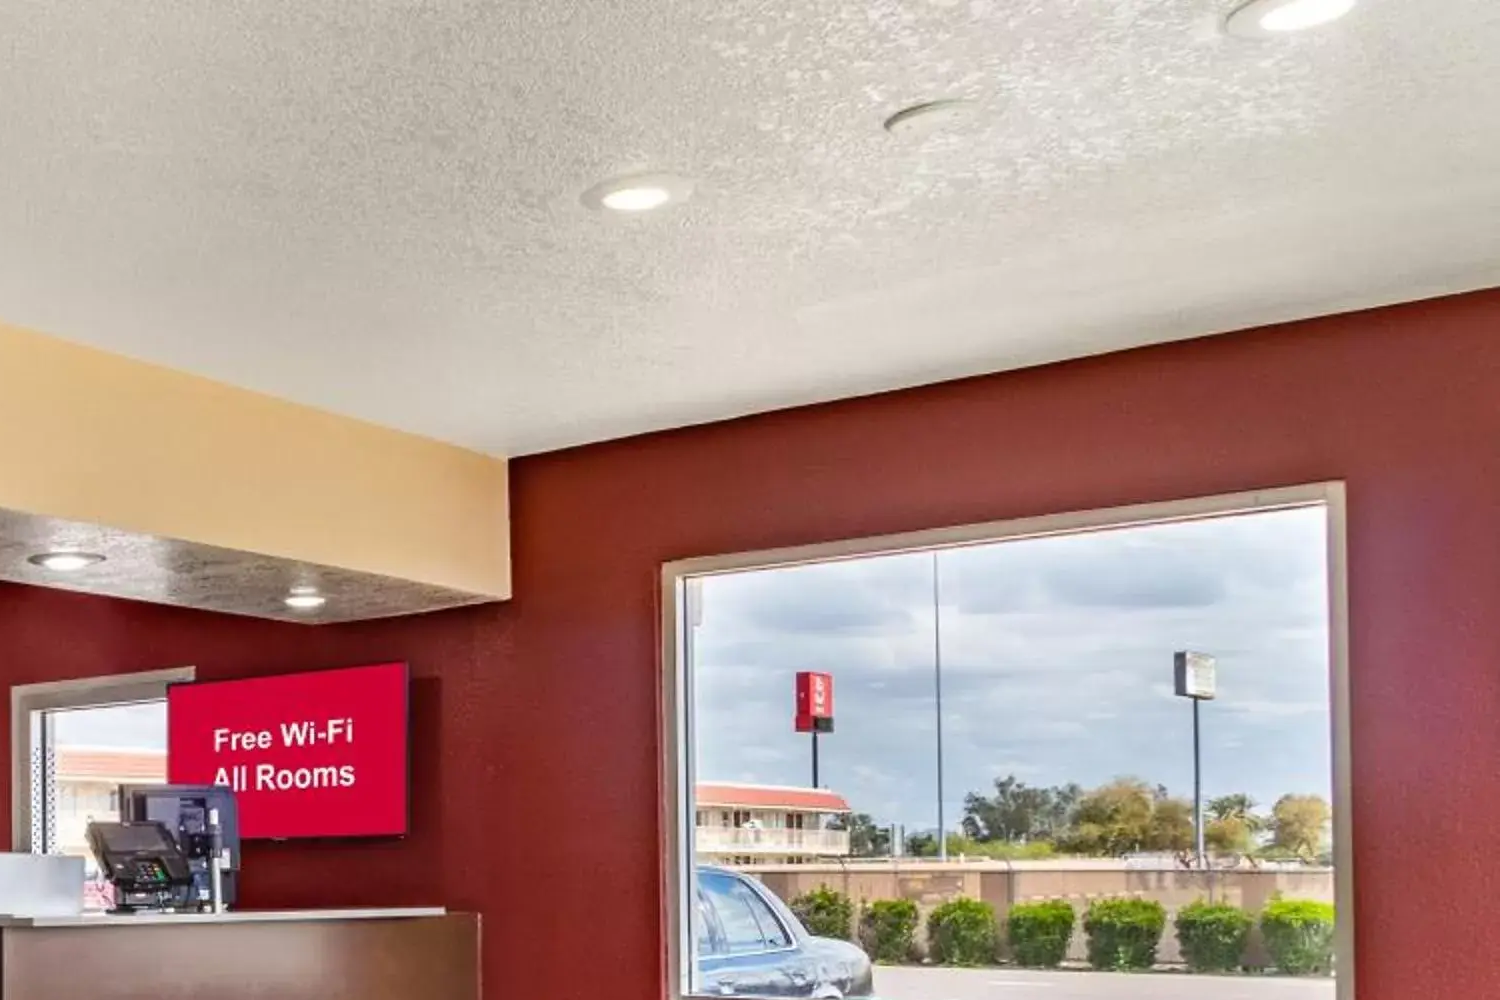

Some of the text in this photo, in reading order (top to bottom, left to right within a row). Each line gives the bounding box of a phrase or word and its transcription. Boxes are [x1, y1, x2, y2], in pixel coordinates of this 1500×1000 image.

[214, 718, 353, 752] Free Wi-Fi
[214, 764, 355, 792] All Rooms
